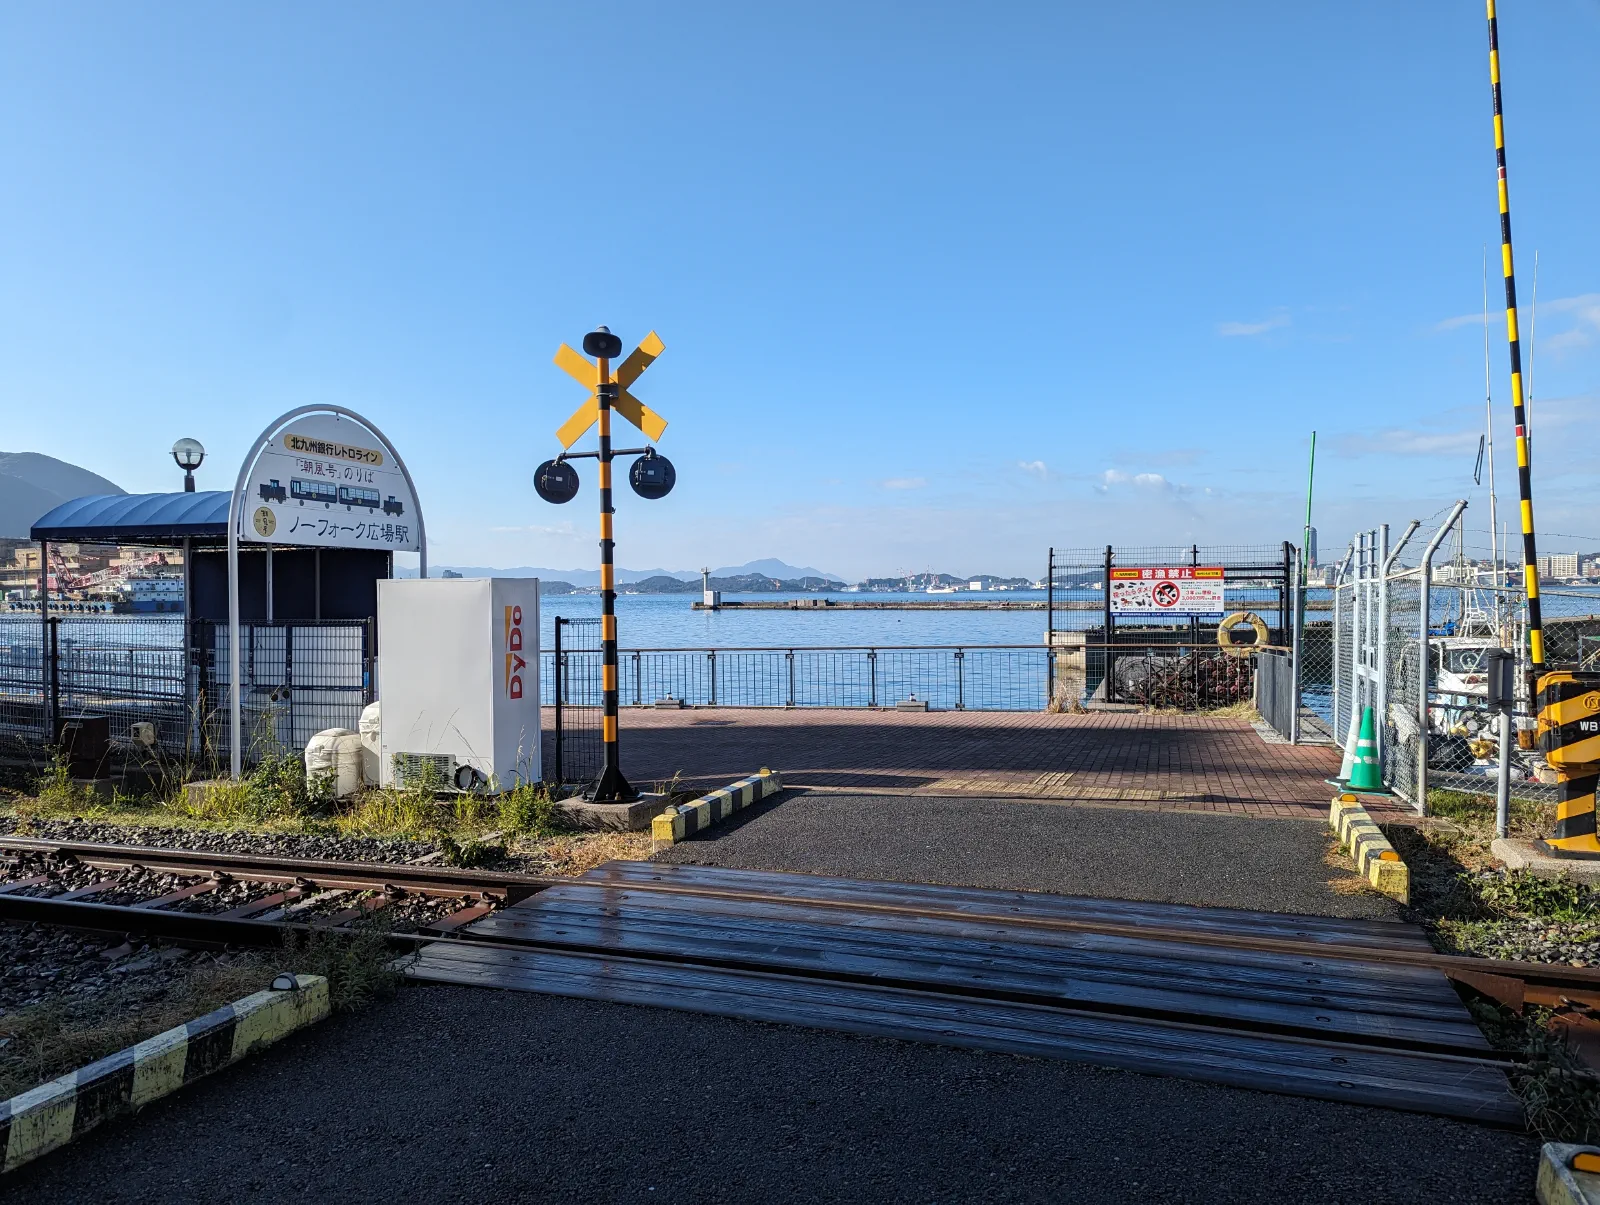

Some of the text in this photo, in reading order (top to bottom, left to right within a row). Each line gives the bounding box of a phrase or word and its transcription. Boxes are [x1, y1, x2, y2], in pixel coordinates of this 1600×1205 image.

[290, 436, 378, 463] 北九州銀行レトロライン
[295, 458, 374, 484] 「潮風号」のりば
[289, 515, 410, 543] ノーフォーク広場駅
[1141, 569, 1192, 579] 密漁禁止
[1579, 721, 1600, 732] WB
